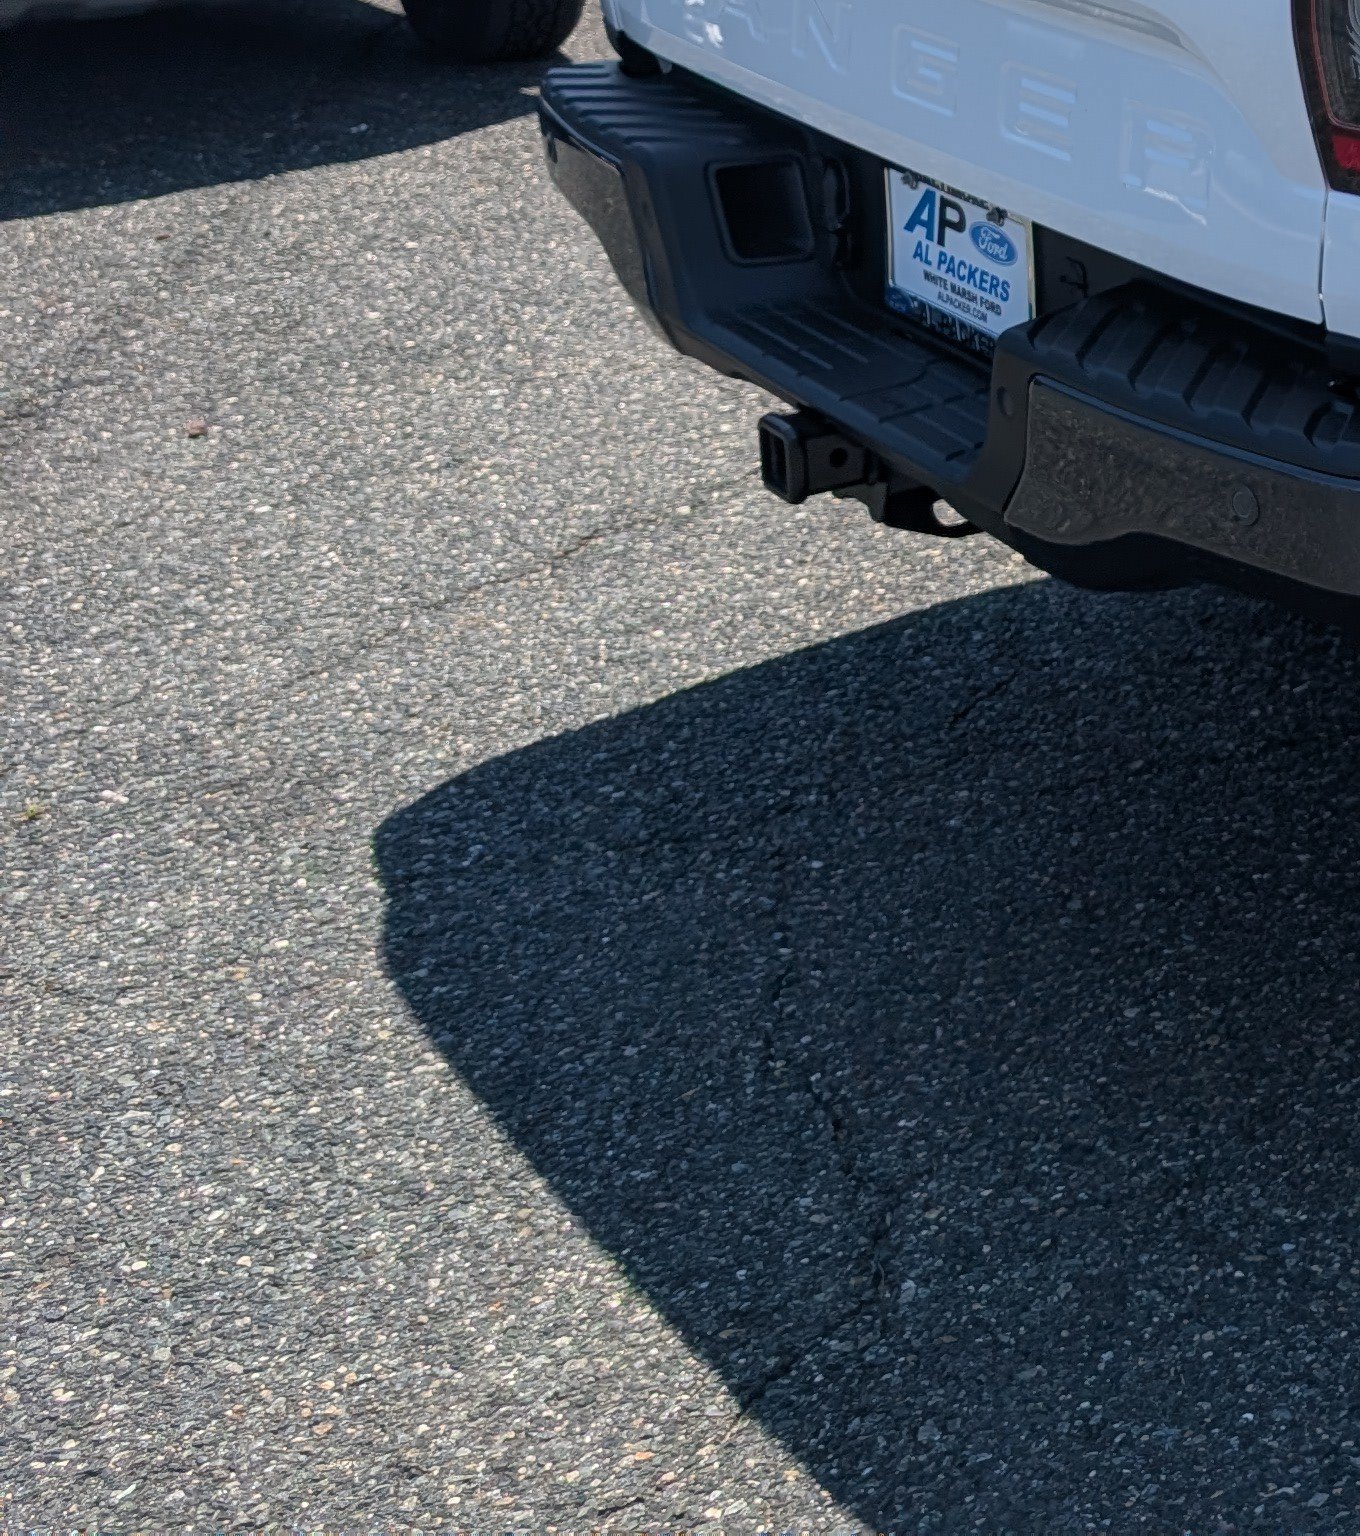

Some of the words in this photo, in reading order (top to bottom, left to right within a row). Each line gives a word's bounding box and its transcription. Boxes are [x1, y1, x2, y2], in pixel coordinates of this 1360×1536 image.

[903, 188, 967, 247] AP
[977, 226, 1009, 261] Ford
[912, 240, 932, 266] AL
[937, 250, 1011, 303] PACKERS
[923, 269, 948, 291] WHITE
[950, 281, 978, 304] MARSH
[980, 295, 1002, 316] FORD
